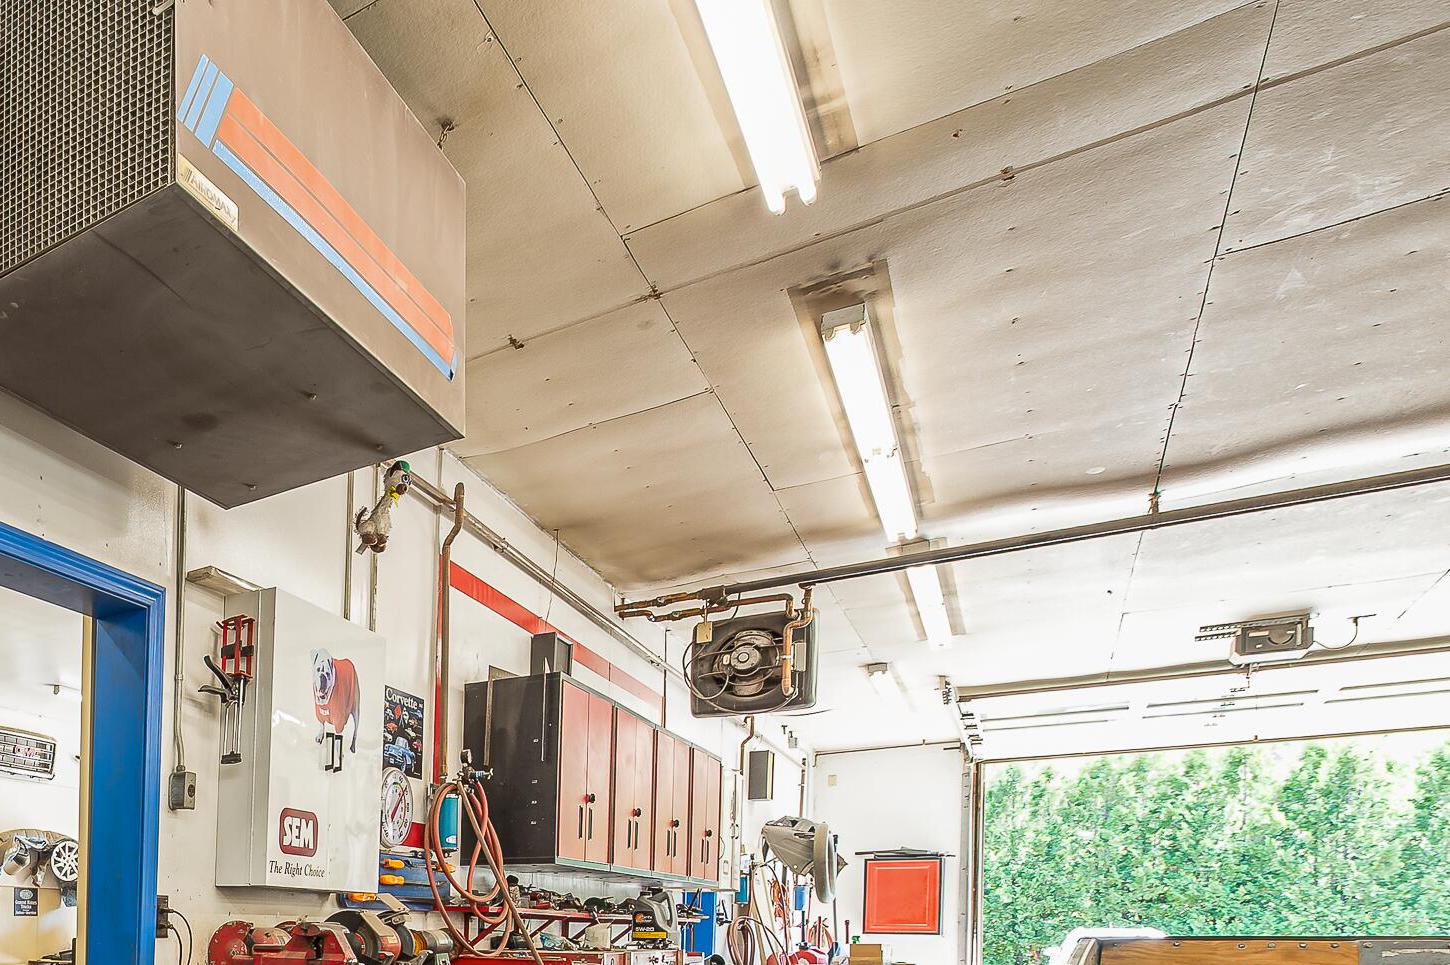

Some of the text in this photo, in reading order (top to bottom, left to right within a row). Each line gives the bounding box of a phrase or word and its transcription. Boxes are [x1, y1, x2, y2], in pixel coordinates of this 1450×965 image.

[386, 688, 417, 709] Corvette
[283, 816, 314, 849] SEM
[270, 860, 325, 877] The Right Choice
